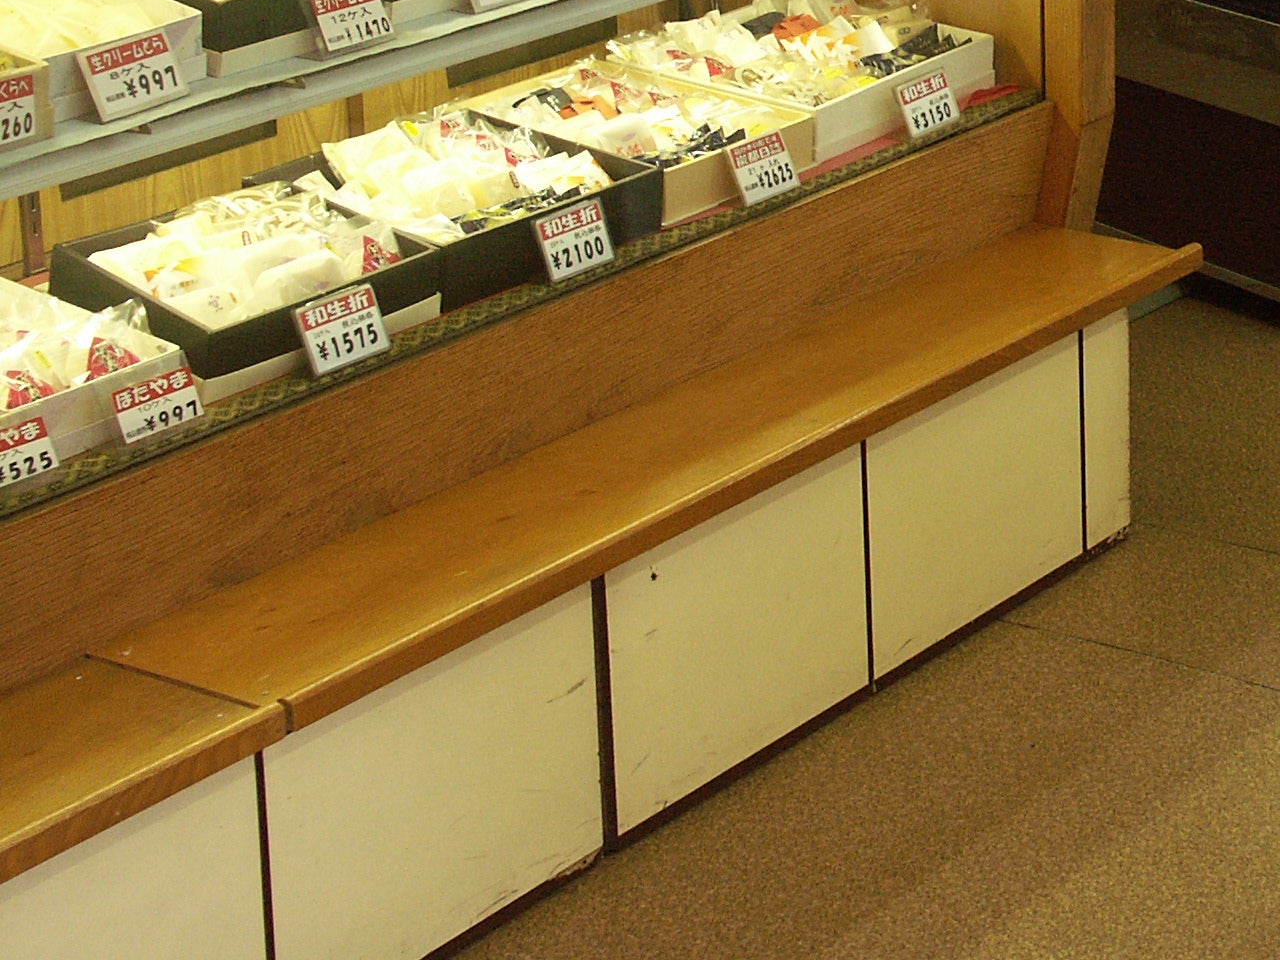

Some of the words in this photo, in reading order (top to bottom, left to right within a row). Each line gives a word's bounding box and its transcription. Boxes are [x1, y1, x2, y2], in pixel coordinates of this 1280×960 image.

[345, 16, 391, 44] ¥1470
[90, 35, 166, 72] 生クリームどら
[123, 64, 179, 99] ¥997
[911, 101, 952, 131] ¥3150
[756, 162, 794, 189] ¥2625
[543, 204, 600, 239] 和生折
[550, 235, 606, 271] ¥2100
[303, 291, 371, 328] 和生折
[315, 322, 380, 360] ¥1575
[143, 399, 198, 431] ¥997
